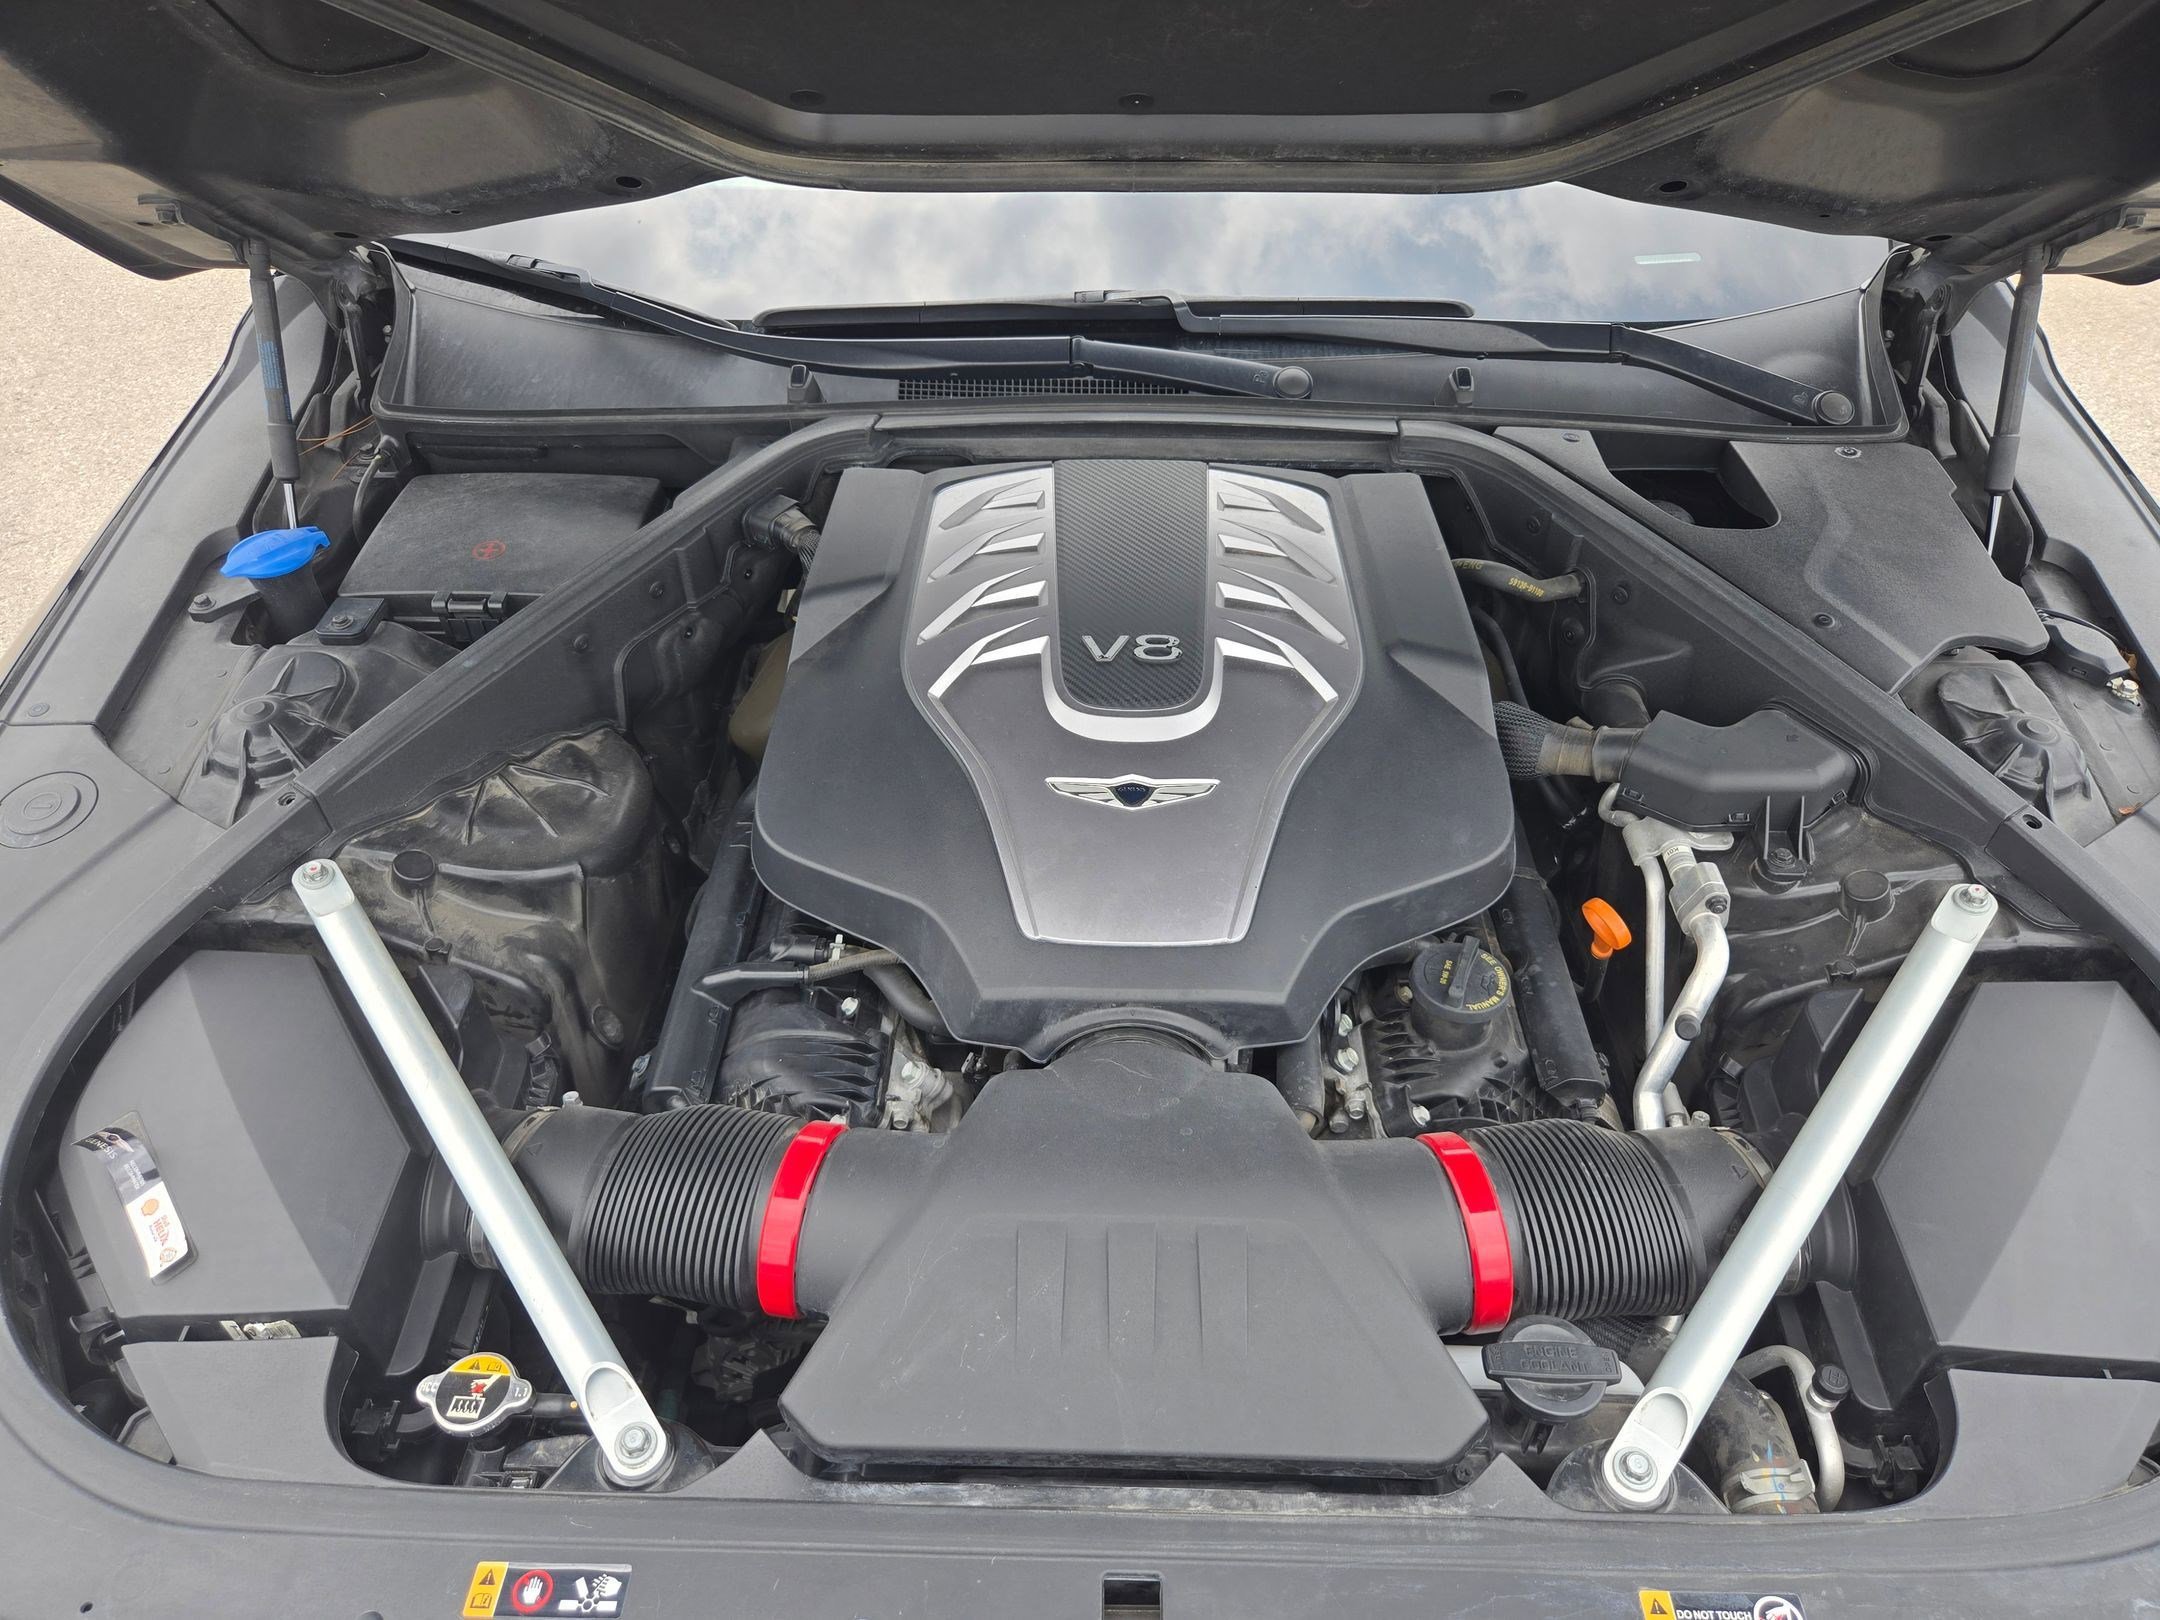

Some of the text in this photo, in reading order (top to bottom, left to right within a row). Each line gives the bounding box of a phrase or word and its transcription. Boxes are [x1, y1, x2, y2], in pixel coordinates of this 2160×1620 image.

[1081, 634, 1183, 662] V8
[1466, 953, 1508, 1011] SEE OWNER'S MANUAL
[85, 1137, 118, 1160] GENESIS
[1523, 1343, 1578, 1359] ENGINE
[1520, 1358, 1589, 1373] COOLANT
[514, 1387, 528, 1398] 1.1
[1676, 1609, 1752, 1620] DO NOT TOUCH
